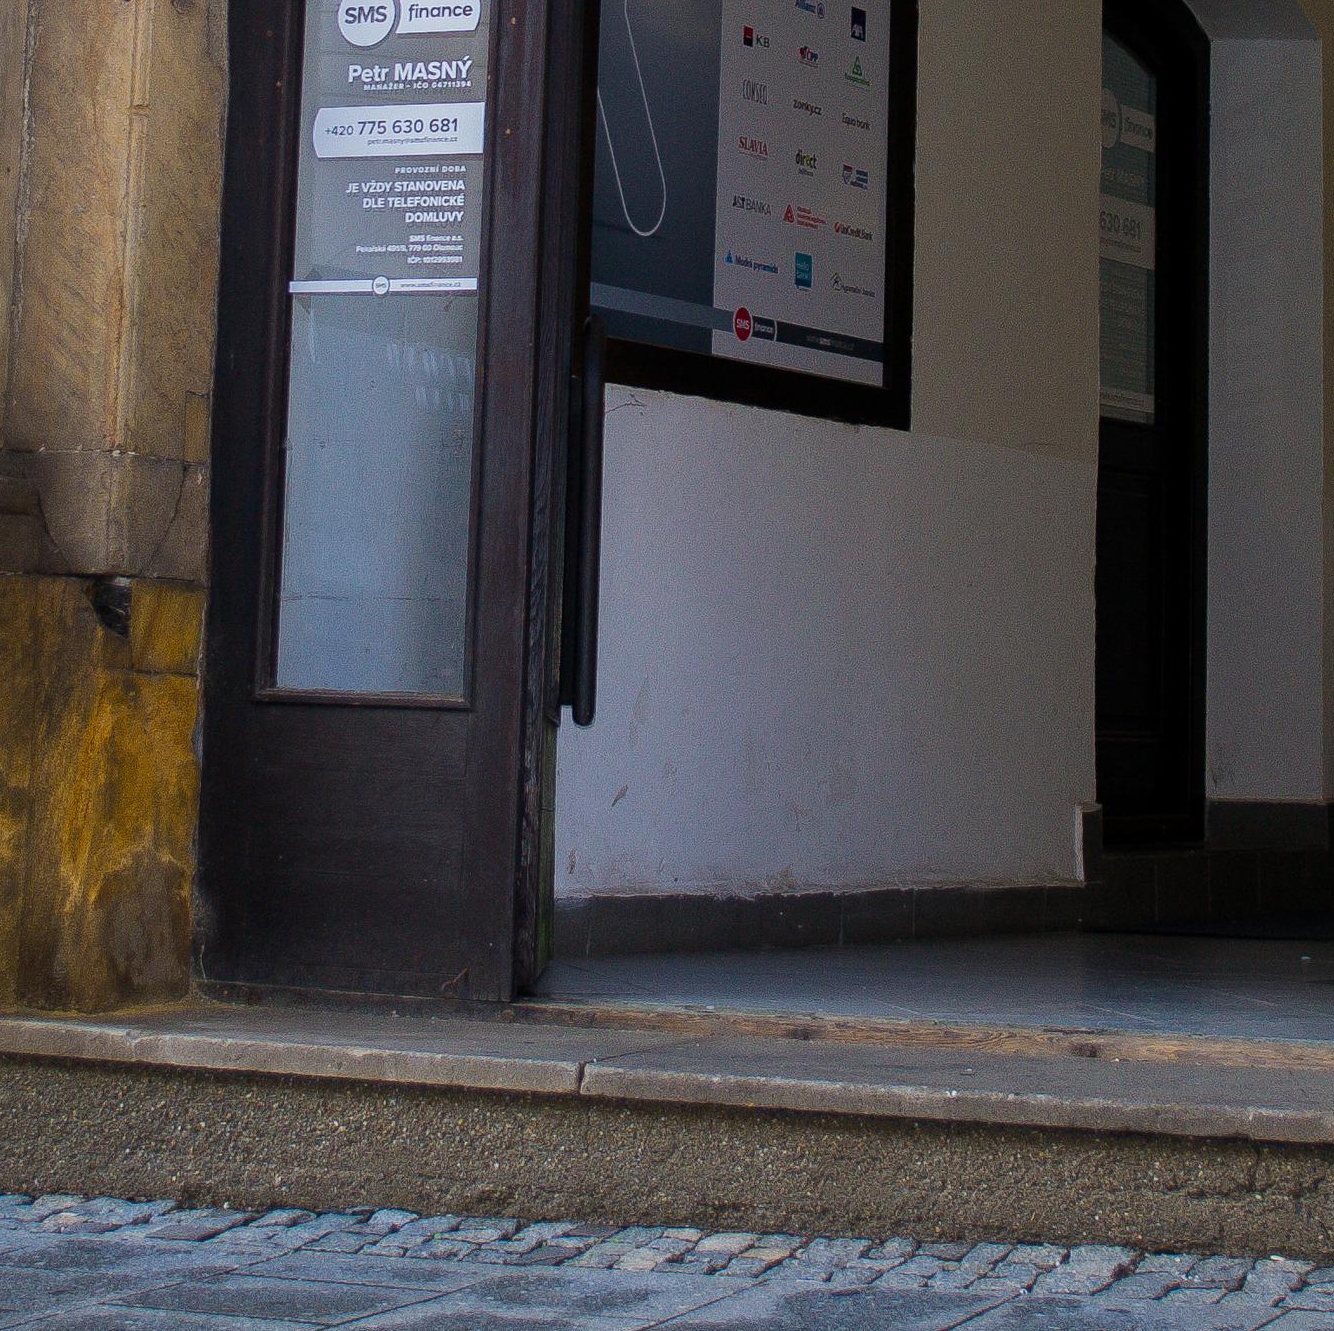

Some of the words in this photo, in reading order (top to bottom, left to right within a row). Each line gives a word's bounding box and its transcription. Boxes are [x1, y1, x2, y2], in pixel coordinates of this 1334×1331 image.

[344, 5, 387, 25] SMS
[408, 3, 473, 22] finance
[348, 64, 390, 83] Petr
[394, 55, 473, 80] MASNÝ
[325, 125, 354, 136] +420
[357, 121, 387, 135] 775
[392, 119, 424, 134] 630
[429, 117, 458, 133] 681
[345, 183, 359, 194] JE
[361, 180, 392, 193] VŽDY
[394, 180, 465, 192] STANOVENA
[363, 197, 384, 208] DLE
[387, 193, 465, 208] TELEFONICKÉ
[405, 211, 464, 223] DOMLUVY
[736, 318, 750, 330] SMS
